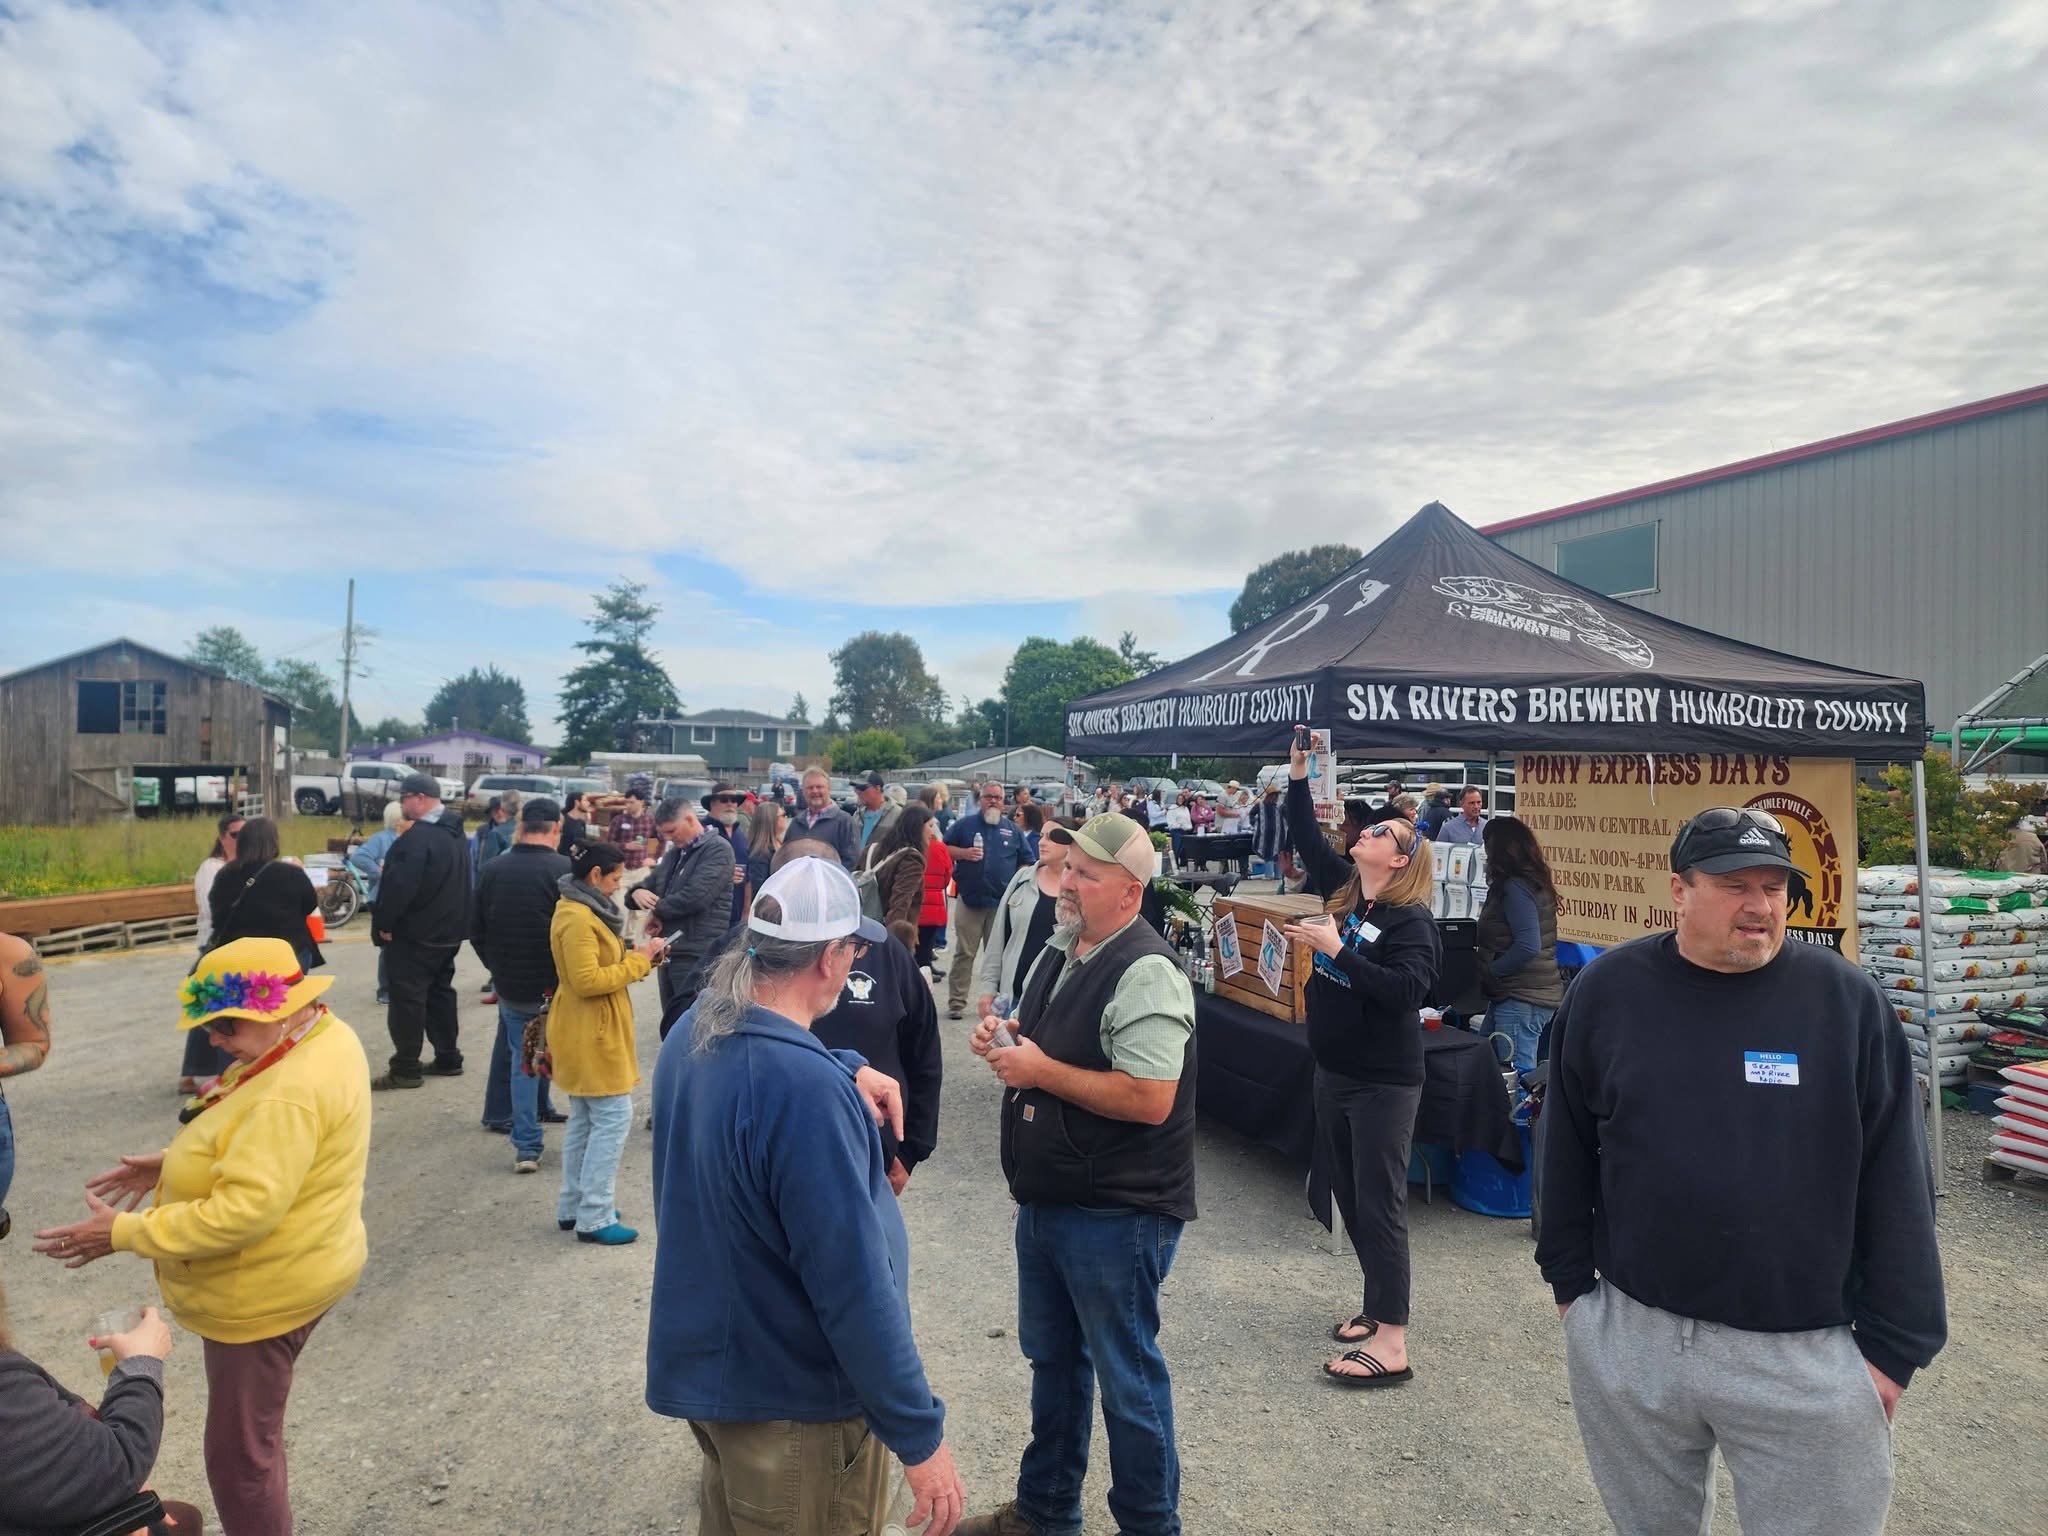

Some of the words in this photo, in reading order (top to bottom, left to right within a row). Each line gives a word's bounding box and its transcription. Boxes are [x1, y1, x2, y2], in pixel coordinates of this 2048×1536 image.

[1067, 711, 1085, 738] SIX
[1084, 706, 1119, 736] RIVERS
[1121, 698, 1177, 732] BREWERY
[1178, 691, 1249, 727] HUMBOLDT
[1249, 683, 1315, 723] COUNTY
[1347, 683, 1400, 722] SIX
[1408, 686, 1518, 723] RIVERS
[1528, 687, 1661, 724] BREWERY
[1669, 689, 1806, 730] HUMBOLDT
[1815, 699, 1910, 734] COUNTY
[1521, 753, 1580, 785] PONY
[1587, 753, 1701, 786] EXPRESS
[1708, 753, 1791, 786] DAYS
[1519, 792, 1577, 809] PARADE:
[1750, 797, 1814, 821] CKINLEYVILLE
[1553, 815, 1597, 833] DOWN
[1599, 816, 1672, 837] CENTRAL
[1740, 837, 1771, 847] adidas
[1542, 846, 1587, 865] TIVAL:
[1589, 849, 1670, 872] NOON-4PM
[1551, 868, 1600, 889] ERSON
[1604, 875, 1646, 894] PARK
[1556, 896, 1618, 921] SATURDAY
[1624, 905, 1638, 924] IN
[1807, 930, 1835, 946] DAYS
